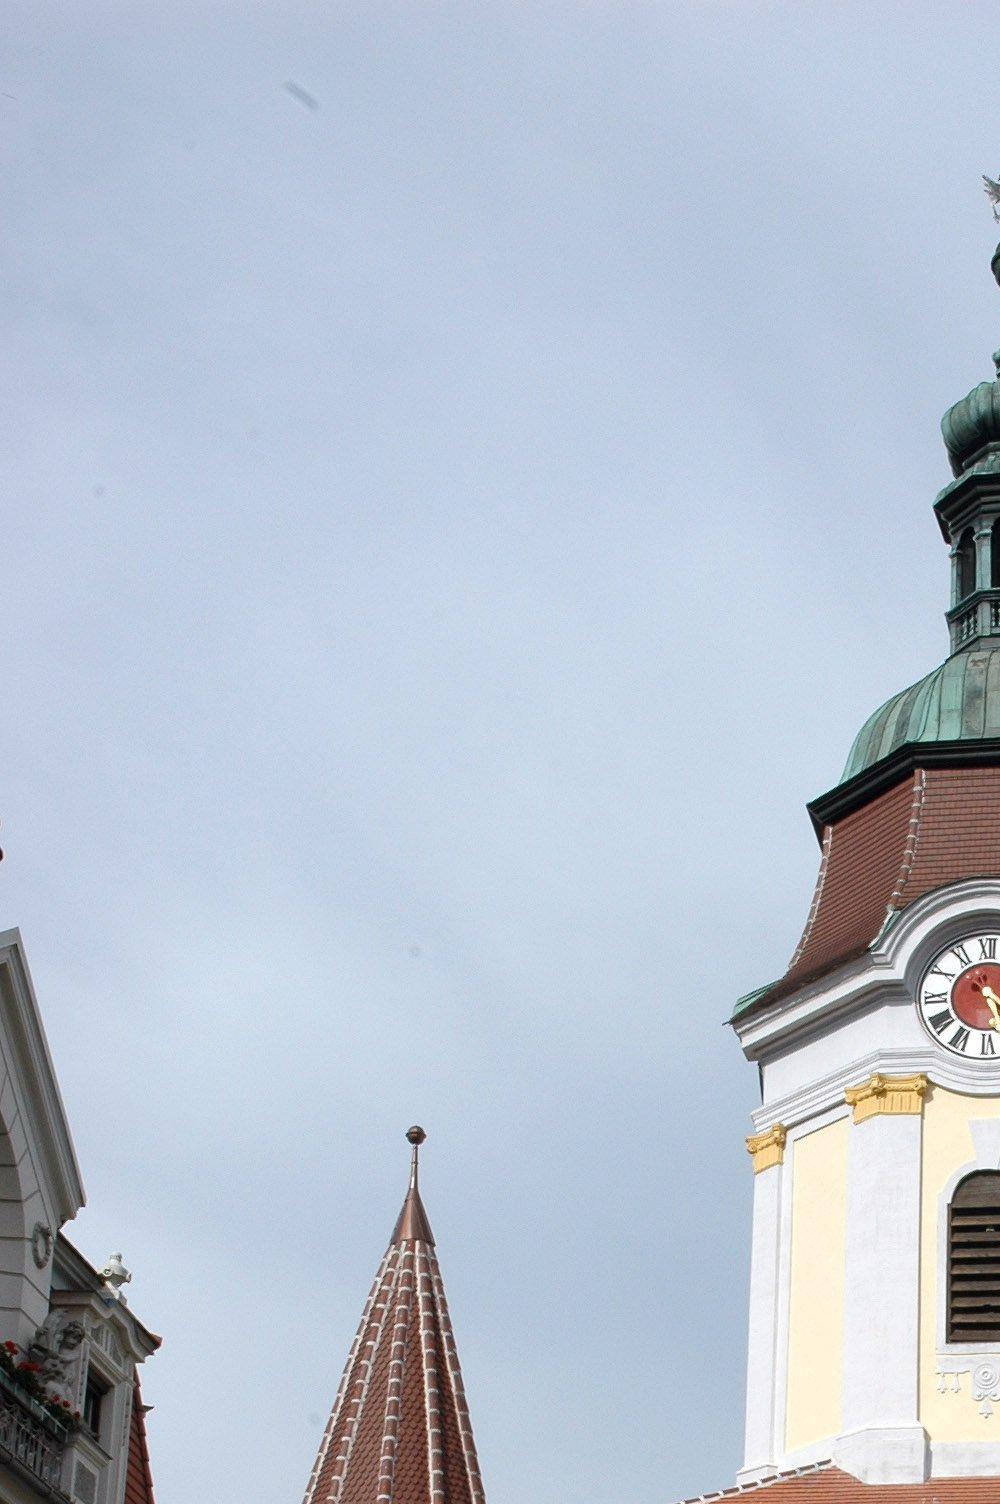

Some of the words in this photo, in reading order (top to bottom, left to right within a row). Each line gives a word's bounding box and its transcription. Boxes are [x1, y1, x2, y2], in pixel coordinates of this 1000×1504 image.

[950, 944, 972, 968] XI
[978, 938, 999, 960] XII
[931, 966, 956, 981] X
[924, 991, 948, 1005] IX
[928, 1009, 955, 1036] VIII
[947, 1026, 972, 1052] VII
[980, 1033, 996, 1055] VI
